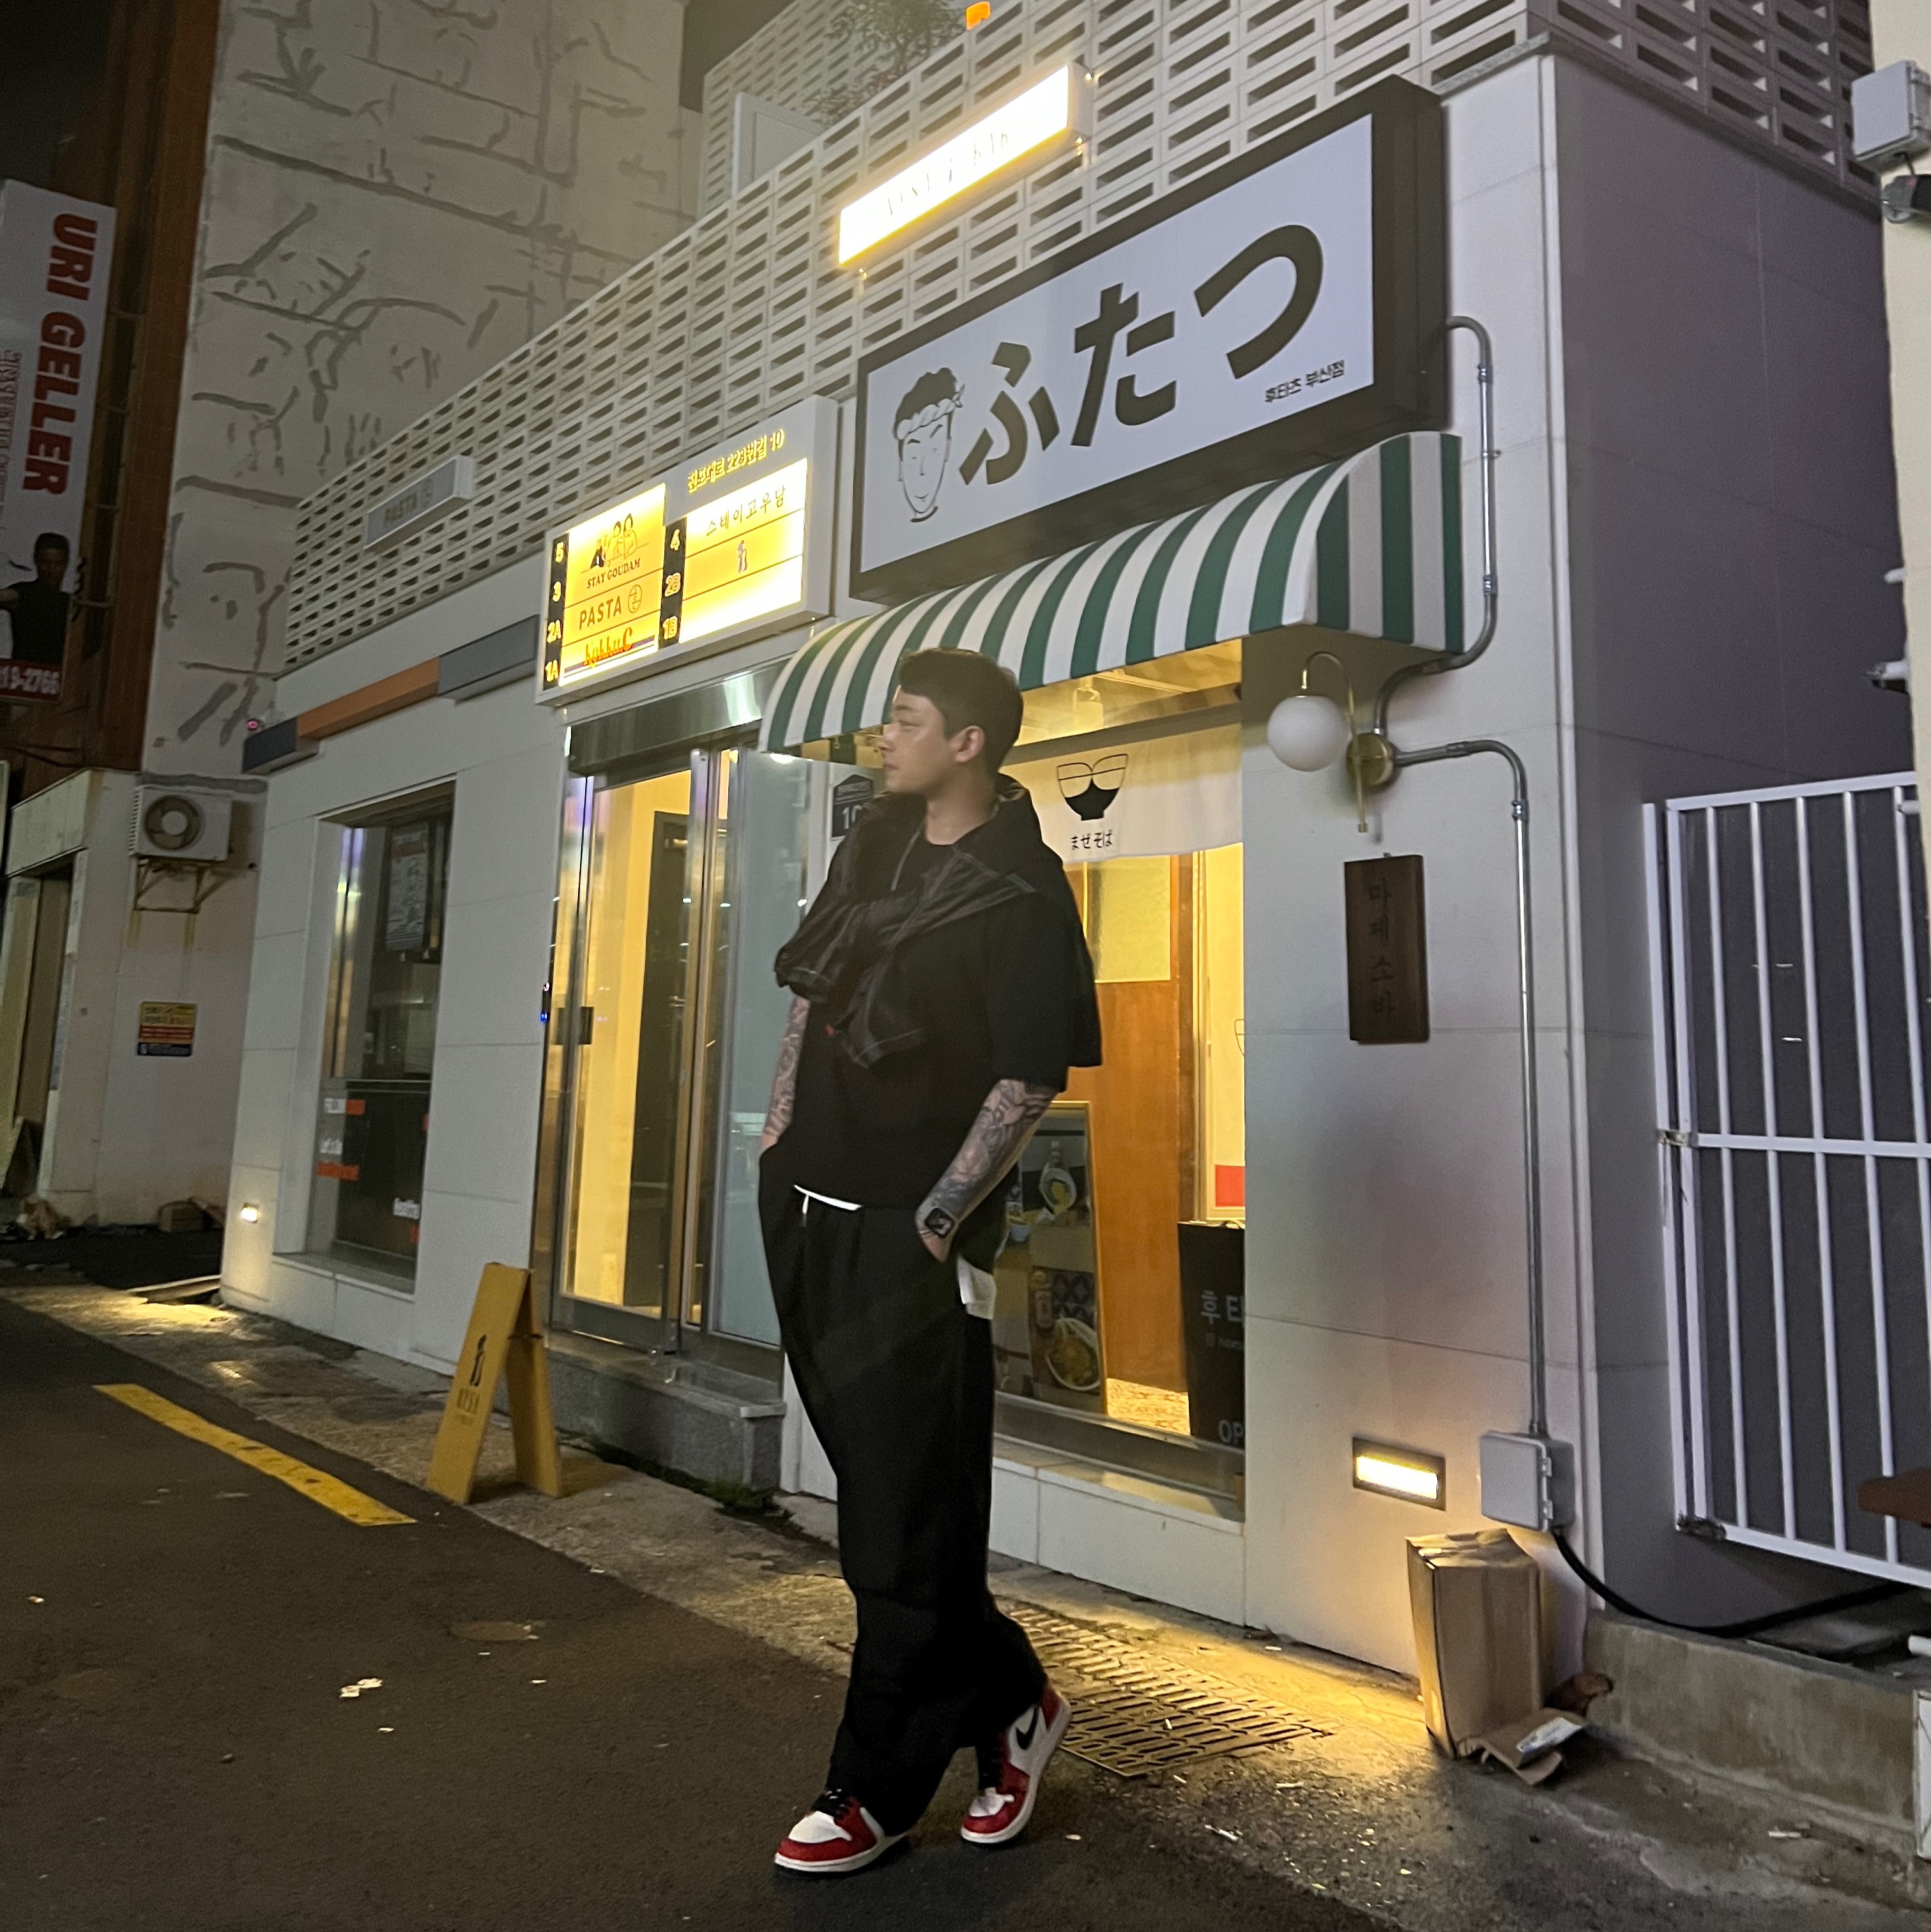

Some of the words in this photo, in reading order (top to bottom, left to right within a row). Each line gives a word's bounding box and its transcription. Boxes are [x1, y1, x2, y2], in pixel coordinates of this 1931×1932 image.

[47, 213, 98, 301] URI
[959, 224, 1325, 487] ふたつ
[22, 310, 86, 496] GELLER
[770, 429, 785, 452] 10
[670, 529, 680, 551] 4
[555, 542, 564, 563] 5
[553, 581, 561, 602] 3
[586, 572, 606, 589] STAY
[665, 572, 681, 597] 2B
[579, 596, 622, 630] PASTA
[547, 620, 562, 644] 2A
[662, 616, 678, 640] 1B
[545, 660, 559, 682] 1A
[1071, 830, 1113, 851] まぜそば
